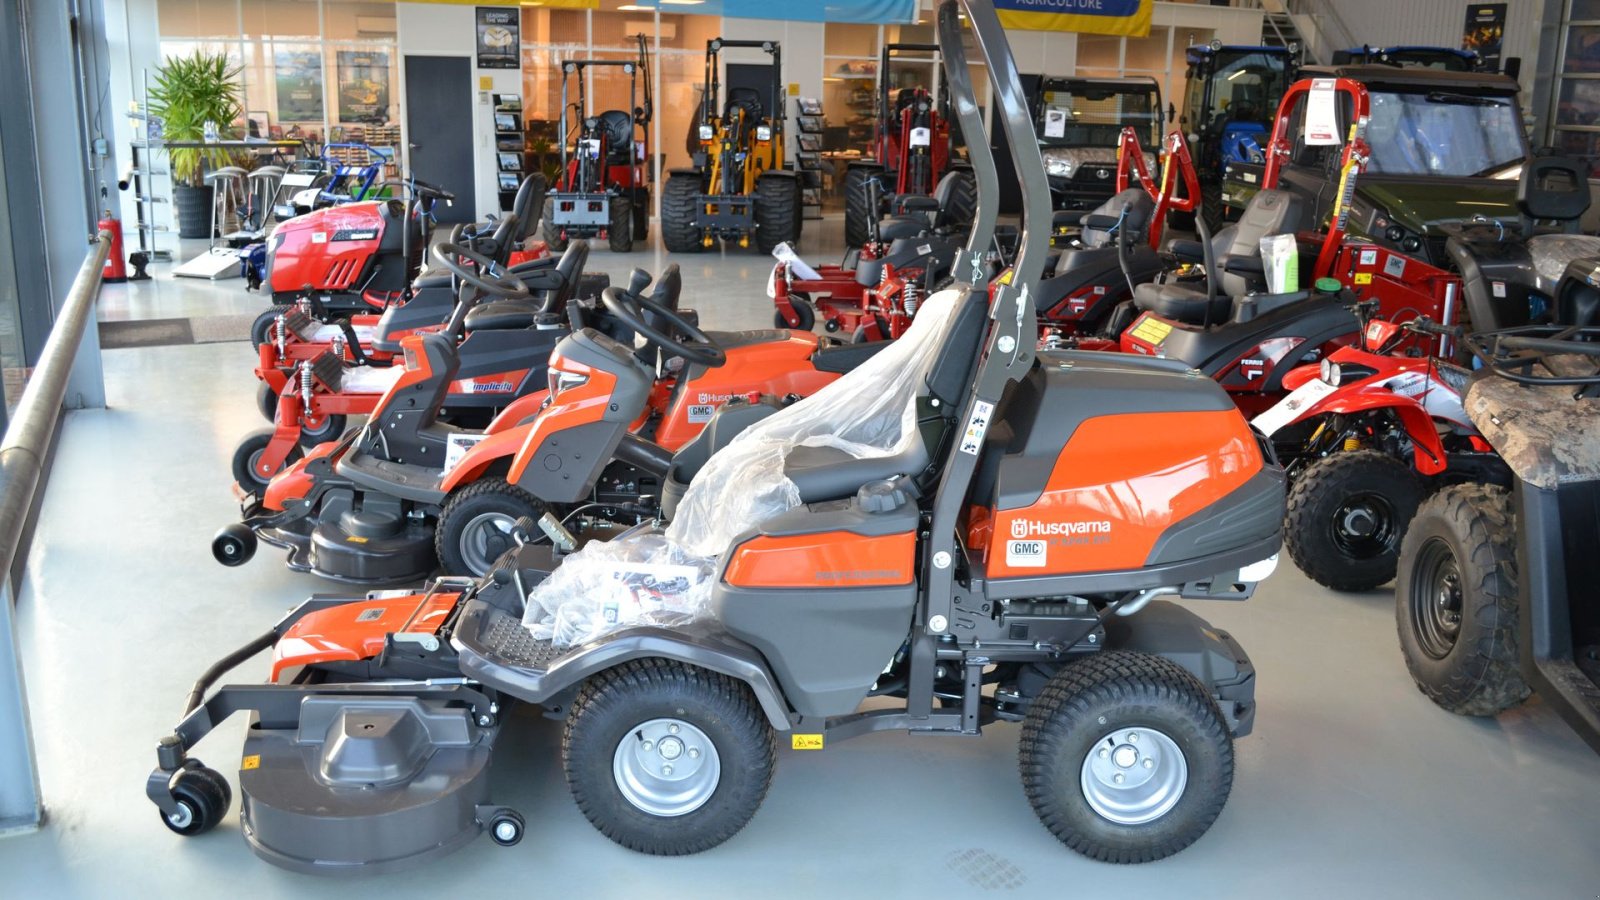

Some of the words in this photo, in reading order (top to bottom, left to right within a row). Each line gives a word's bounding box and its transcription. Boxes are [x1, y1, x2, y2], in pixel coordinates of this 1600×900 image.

[692, 406, 710, 415] GMC
[1029, 520, 1111, 536] Husqvarna
[1014, 543, 1039, 554] GMC
